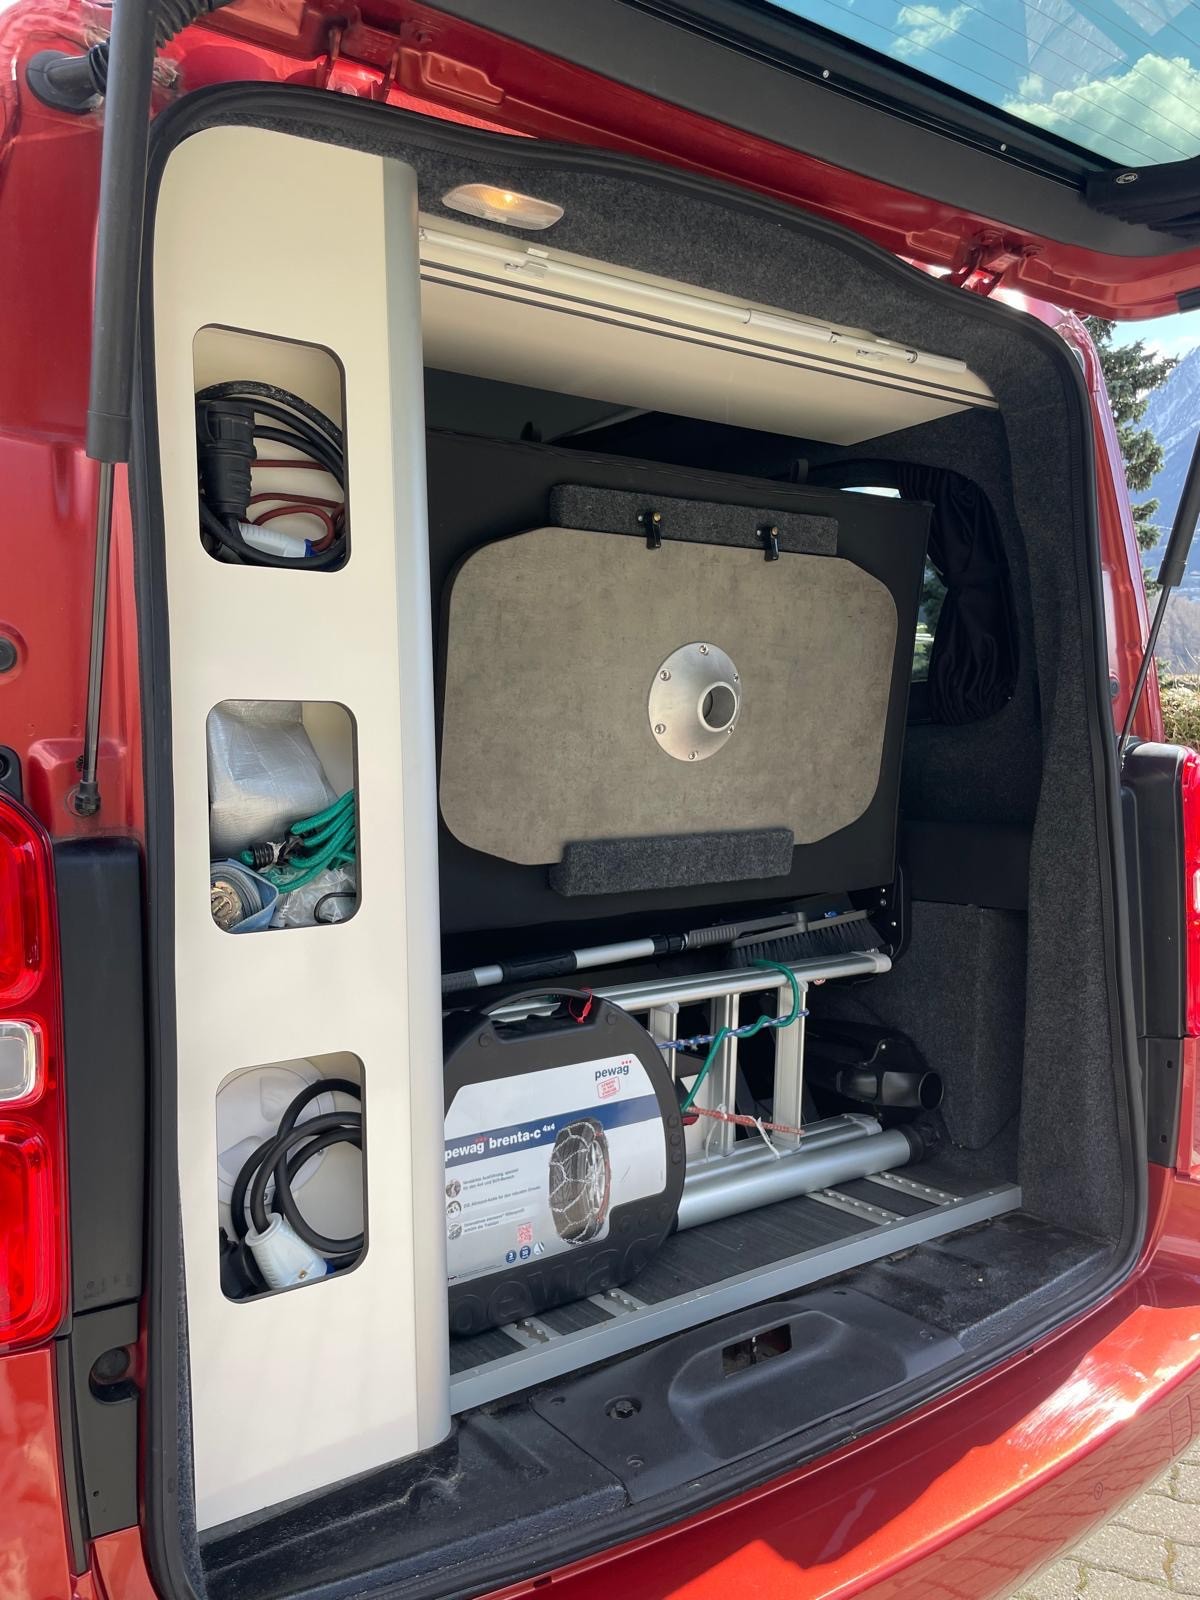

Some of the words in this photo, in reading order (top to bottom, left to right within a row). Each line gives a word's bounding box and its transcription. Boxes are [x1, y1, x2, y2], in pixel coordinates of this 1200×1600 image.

[595, 1065, 630, 1081] pewag
[445, 1142, 485, 1161] pewag
[542, 1123, 556, 1132] 4x4
